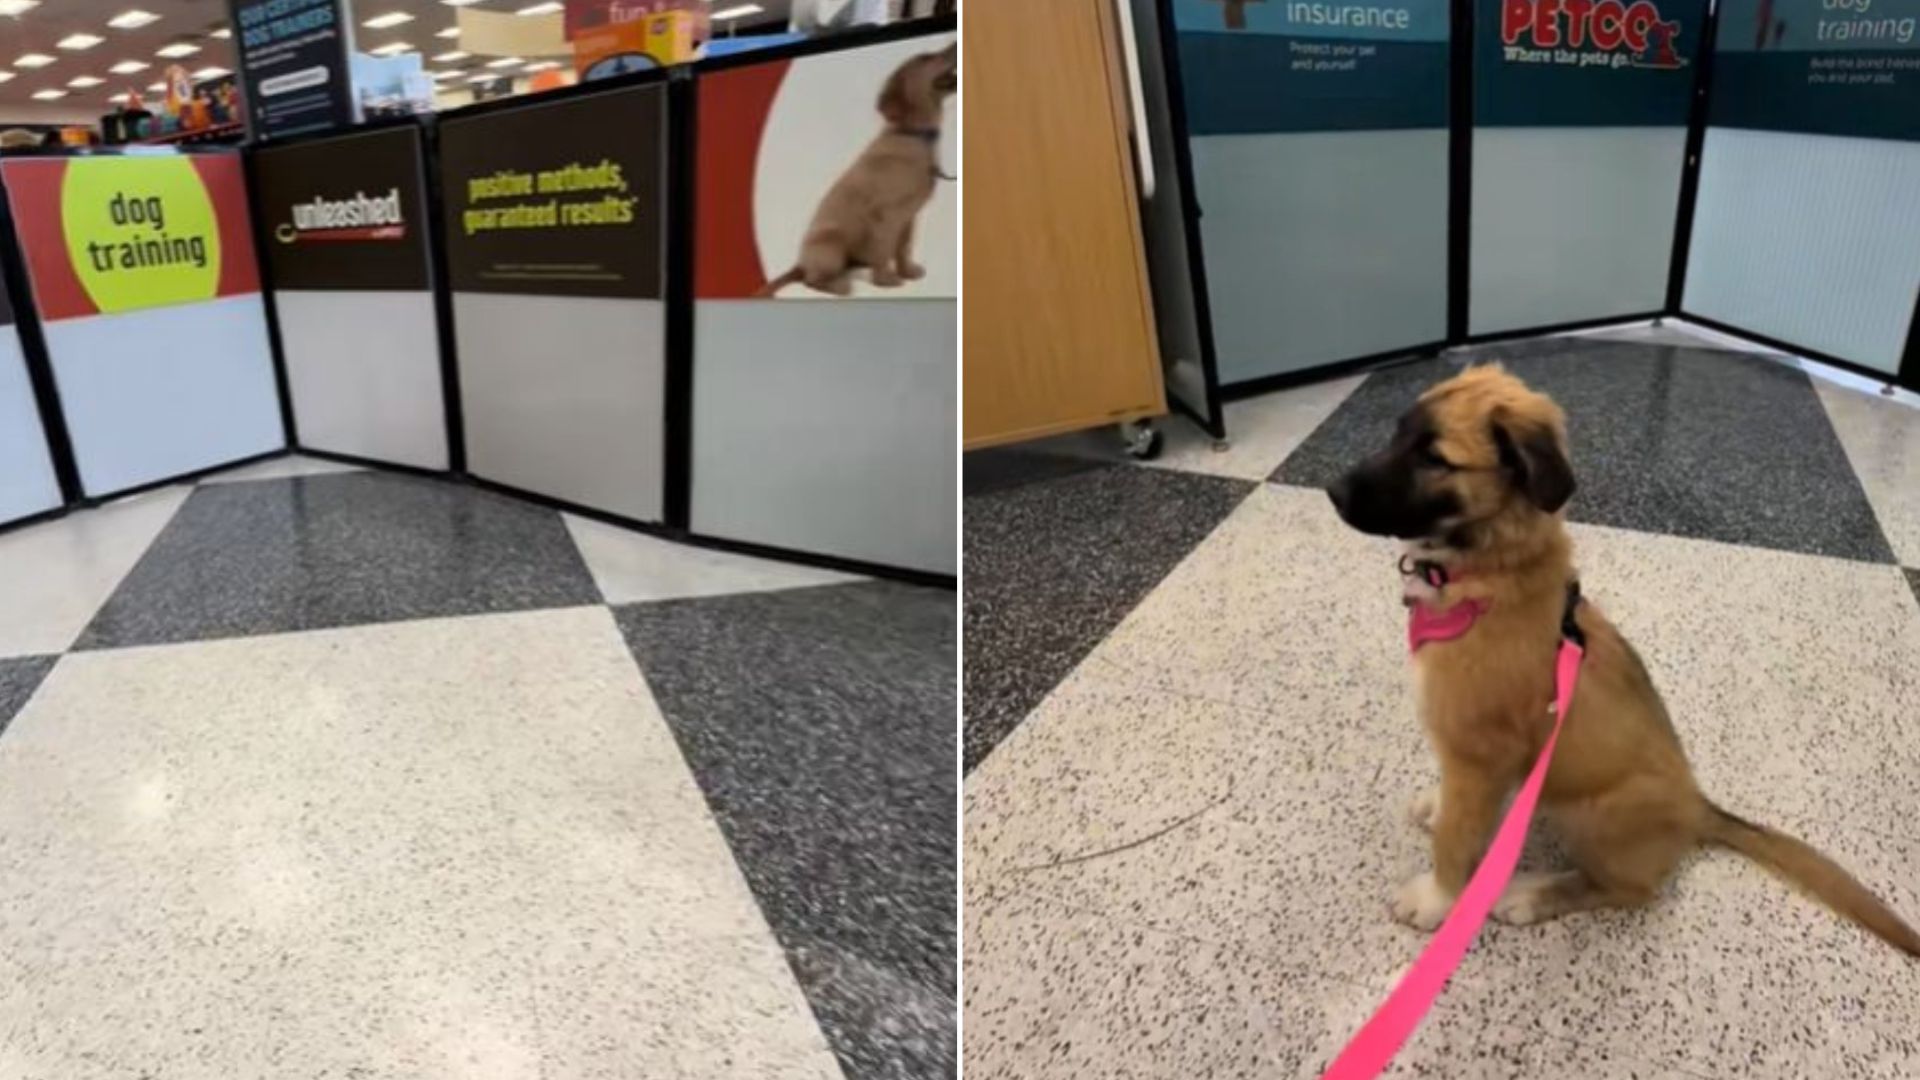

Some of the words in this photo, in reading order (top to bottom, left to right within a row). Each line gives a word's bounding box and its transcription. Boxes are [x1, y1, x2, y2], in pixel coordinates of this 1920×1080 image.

[1287, 0, 1409, 29] insurance
[1503, 0, 1660, 51] PETCO
[1818, 15, 1915, 43] training
[1289, 41, 1330, 55] Protect
[1332, 45, 1356, 57] your
[1358, 45, 1377, 57] pet
[1291, 59, 1313, 70] and
[1503, 46, 1551, 62] Where
[1554, 49, 1578, 64] the
[1580, 52, 1609, 67] pets
[469, 169, 533, 203] positive
[537, 160, 627, 192] methods,
[110, 191, 164, 230] dog
[291, 188, 401, 230] unleashed
[464, 199, 557, 234] guaranteed
[88, 232, 207, 272] training
